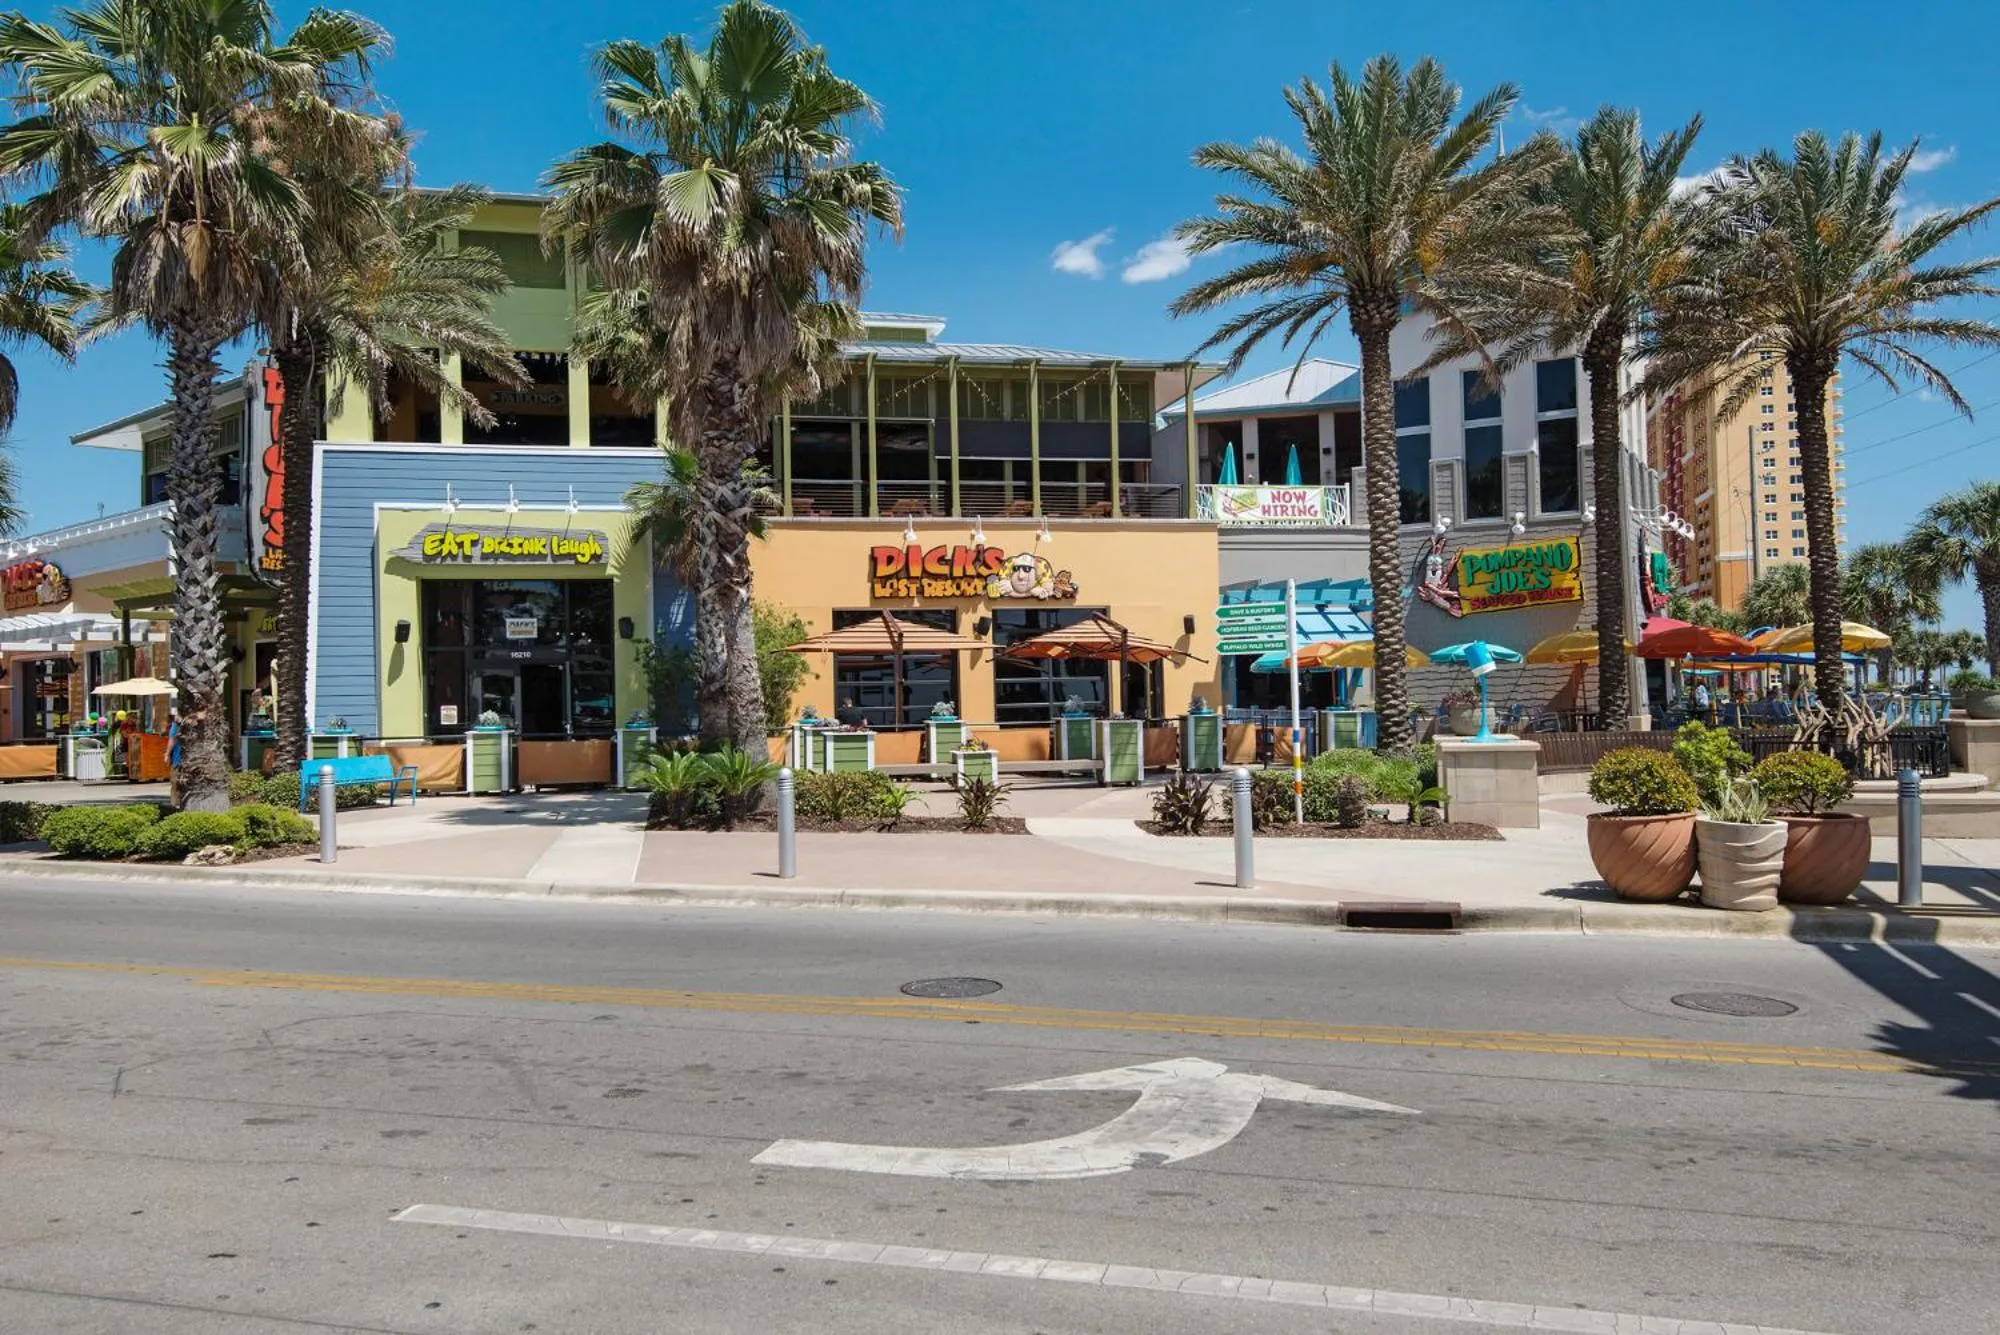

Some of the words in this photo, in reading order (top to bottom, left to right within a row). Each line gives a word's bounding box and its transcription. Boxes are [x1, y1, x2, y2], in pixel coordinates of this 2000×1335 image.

[1270, 490, 1307, 504] NOW
[1261, 504, 1319, 517] HIRING
[423, 530, 480, 557] EAT
[481, 535, 548, 555] DRINK
[551, 534, 602, 564] laugh
[871, 544, 1005, 577] DICK'S
[1461, 542, 1573, 587] POMPANO
[873, 577, 919, 598] LAST
[921, 577, 986, 598] RESORT
[1486, 567, 1552, 595] JOE'S
[1248, 642, 1264, 650] WILD
